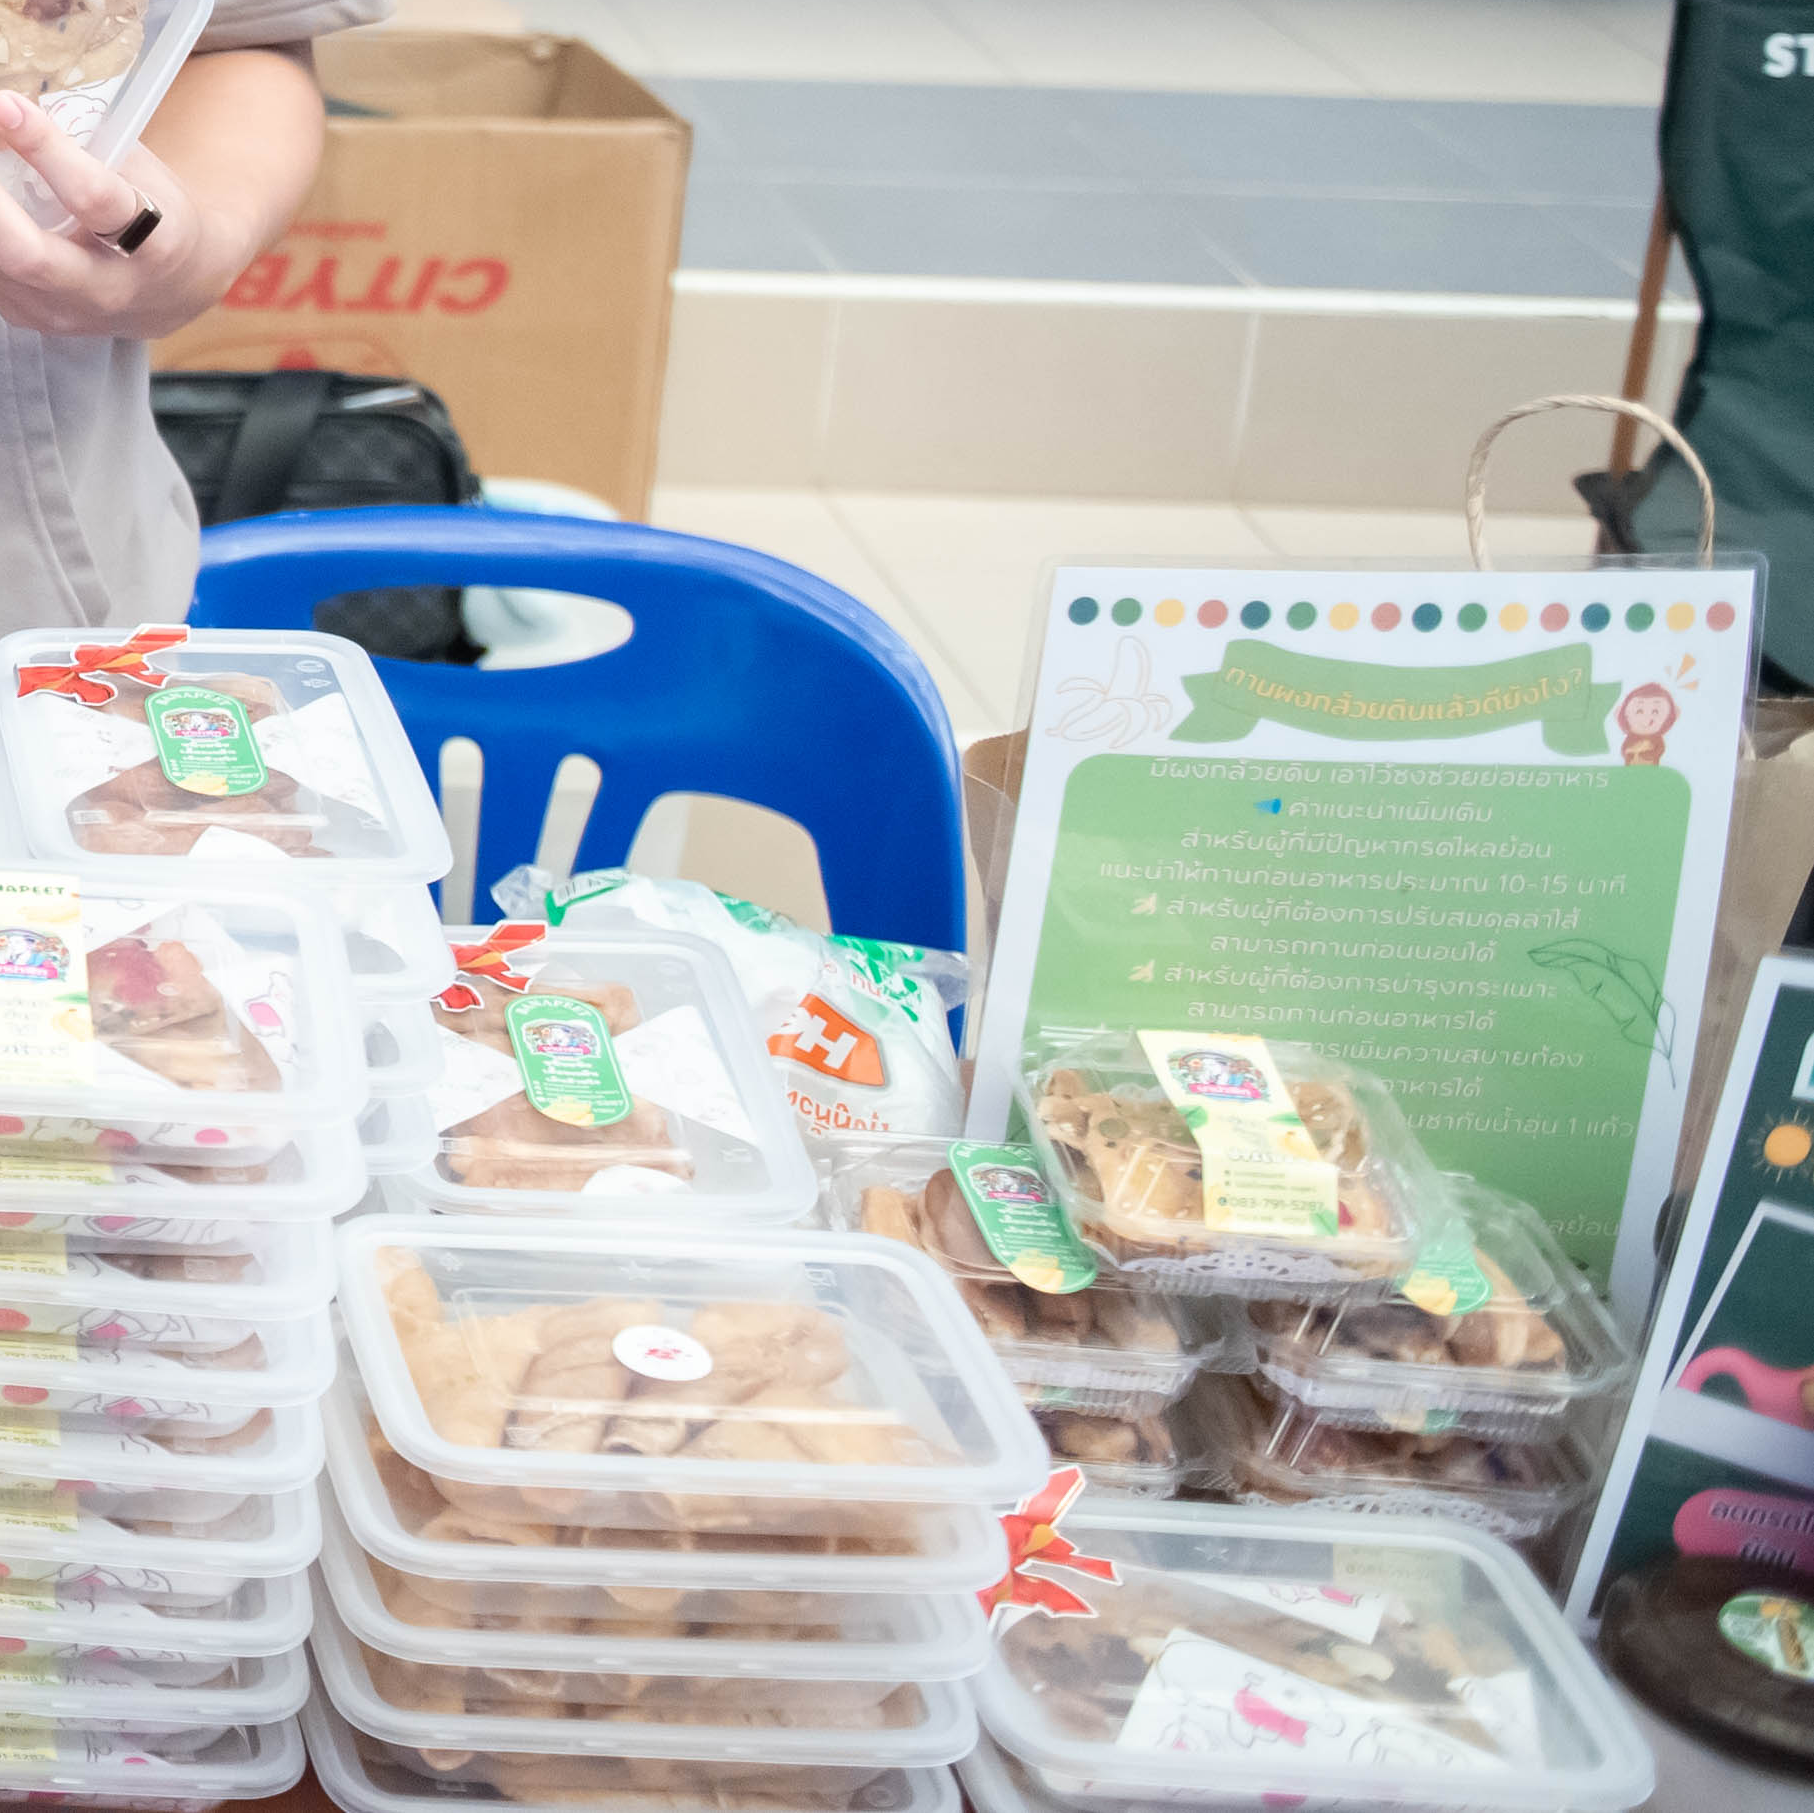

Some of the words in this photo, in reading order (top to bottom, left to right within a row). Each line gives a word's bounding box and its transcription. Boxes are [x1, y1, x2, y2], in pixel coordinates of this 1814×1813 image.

[1289, 794, 1493, 823] คำแนะนำเพิ่มเติม
[1499, 875, 1568, 895] 10-15
[1577, 874, 1627, 896] นาที
[1305, 1040, 1583, 1068] ารเพิ่มความสบายท้อง
[1381, 1076, 1484, 1099] อาหารได้
